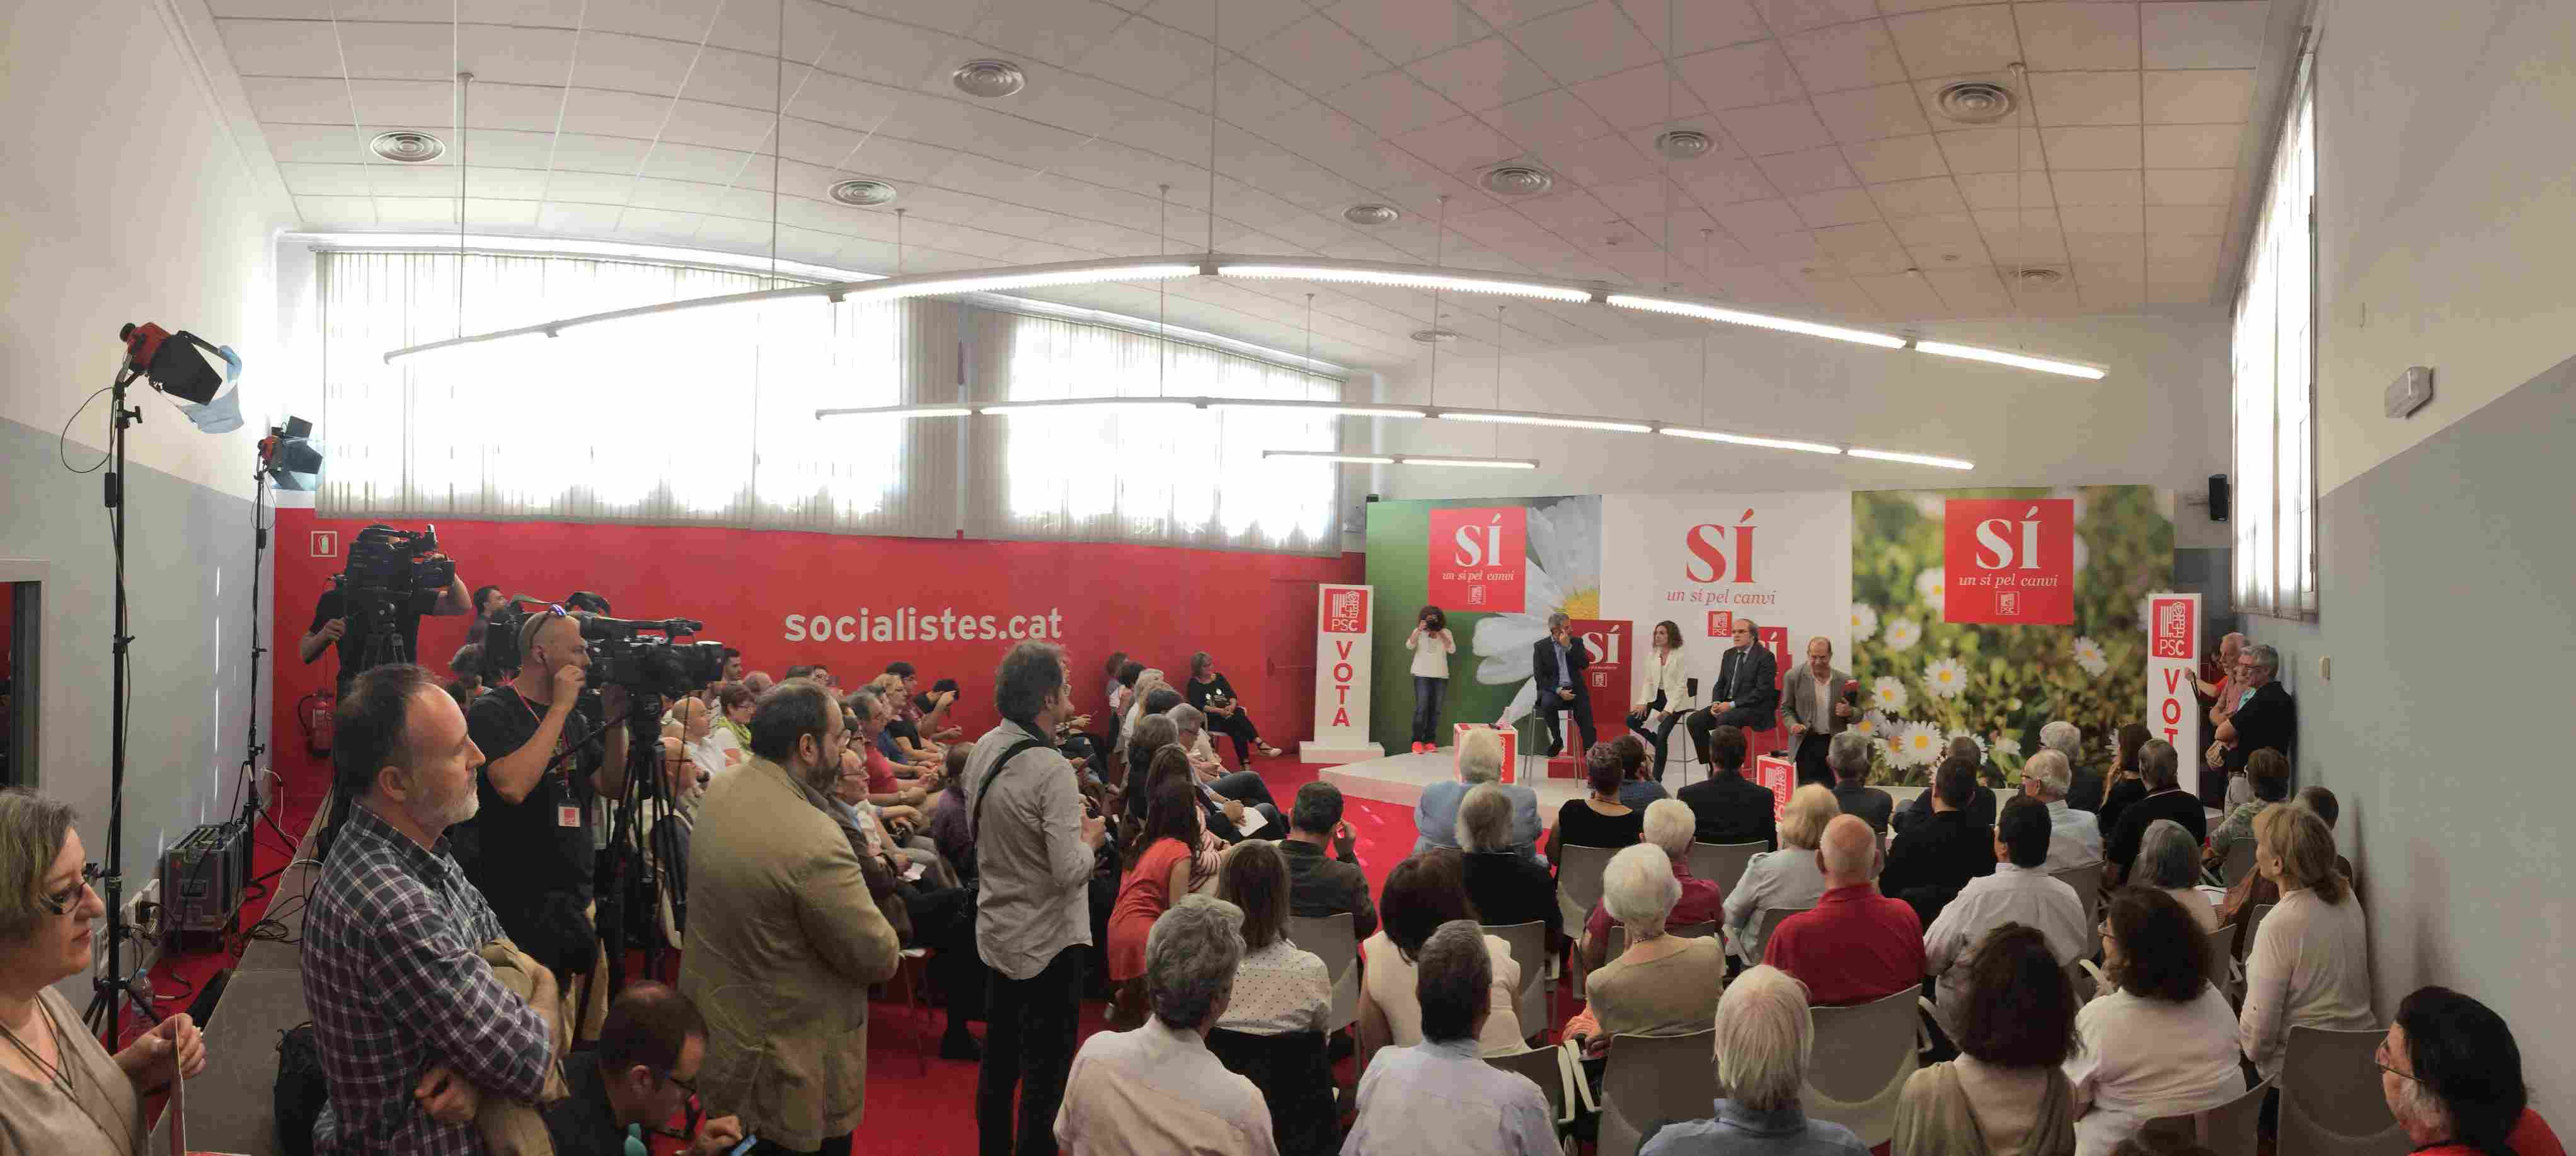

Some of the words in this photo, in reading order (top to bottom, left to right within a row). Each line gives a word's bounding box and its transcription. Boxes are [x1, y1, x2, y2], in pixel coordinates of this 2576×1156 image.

[1456, 513, 1503, 567] SÍ
[1686, 508, 1758, 583] SÍ
[1975, 506, 2042, 570] SÍ
[1442, 572, 1454, 581] un
[1467, 569, 1483, 582] pel
[1486, 570, 1514, 581] canvi
[1958, 576, 1976, 586] un
[1994, 573, 2016, 588] pel
[2021, 574, 2058, 587] canvi
[1667, 590, 1685, 602] un
[1705, 588, 1730, 605] pel
[1734, 589, 1778, 605] canvi
[785, 606, 1062, 642] socialistes.cat
[1331, 618, 1358, 631] PSC
[1582, 625, 1620, 664] SÍ
[2159, 639, 2185, 656] PSC
[1332, 640, 1354, 726] VOTA
[2162, 668, 2181, 747] VOT
